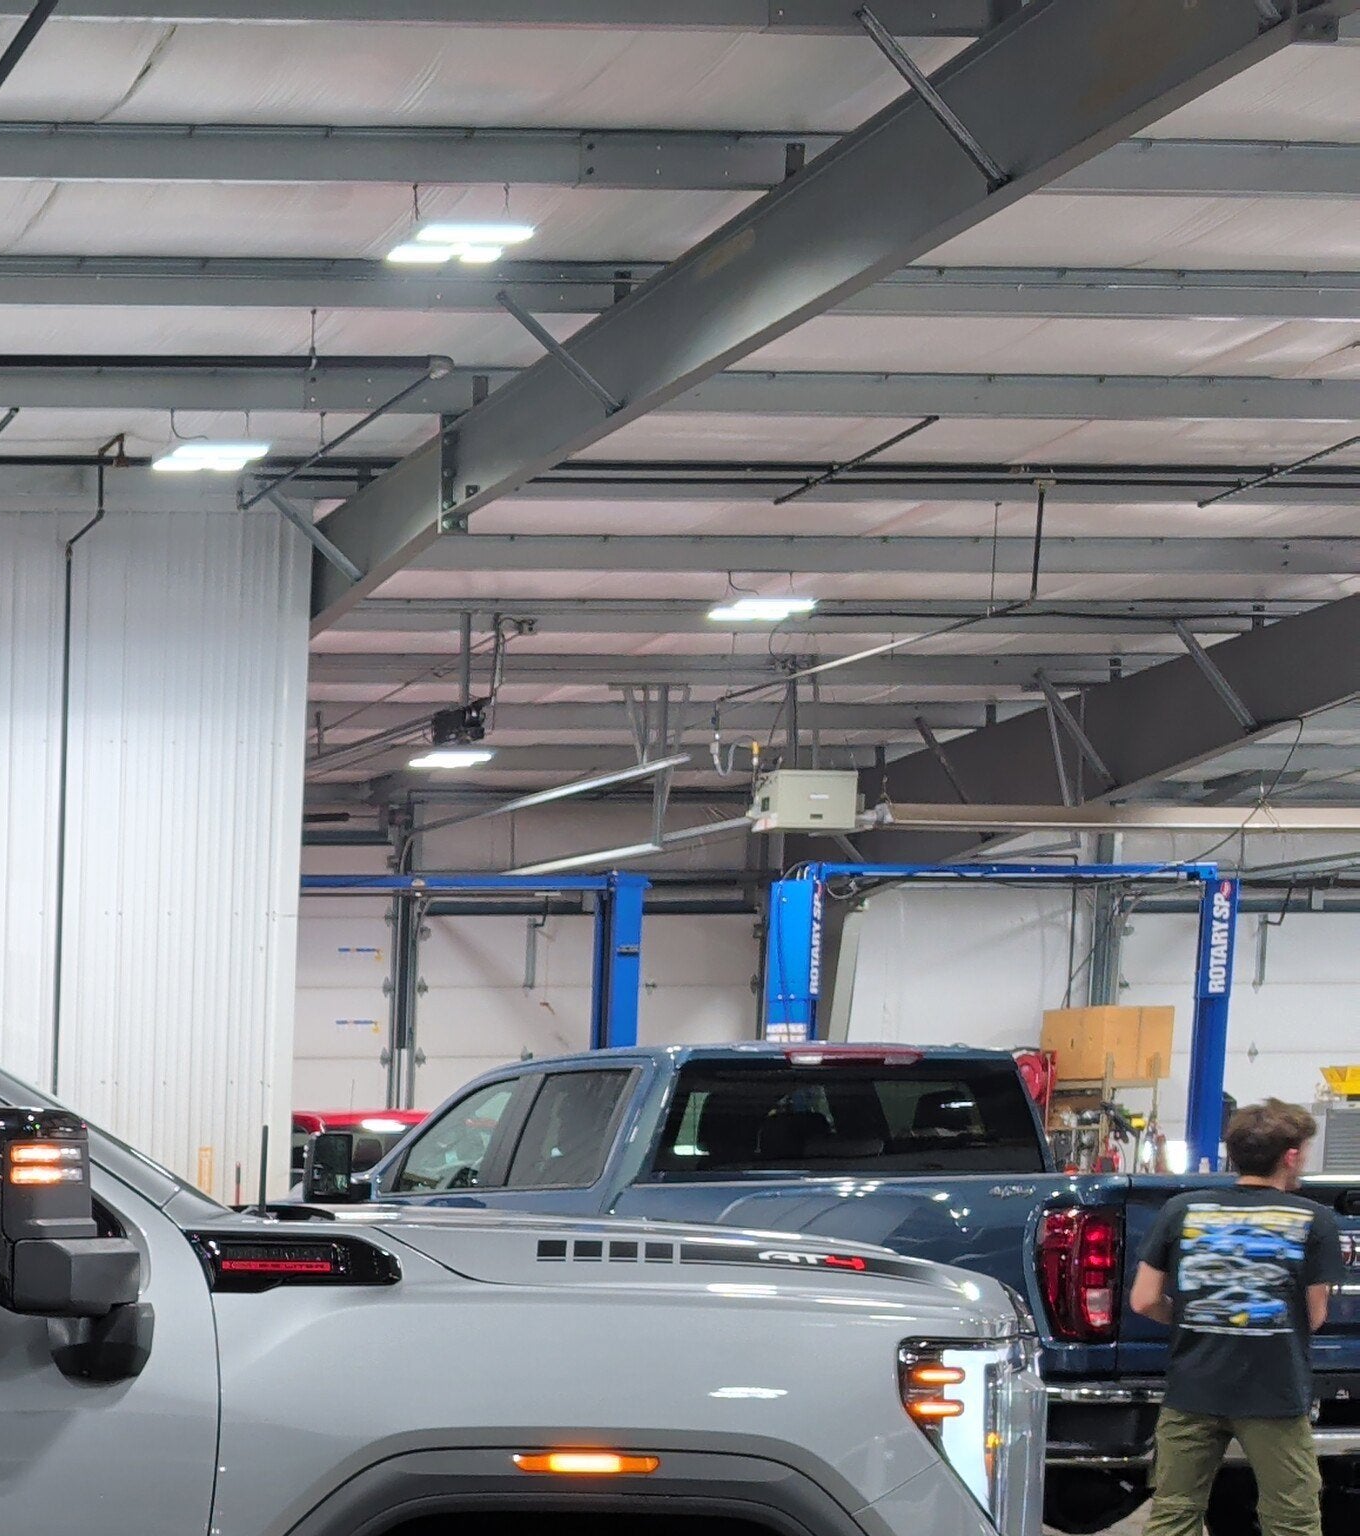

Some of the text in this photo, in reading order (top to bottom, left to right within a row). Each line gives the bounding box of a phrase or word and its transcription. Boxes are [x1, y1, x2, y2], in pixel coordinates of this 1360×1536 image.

[810, 921, 821, 994] ROTARY
[1208, 922, 1228, 993] ROTARY
[757, 1250, 866, 1271] AT4
